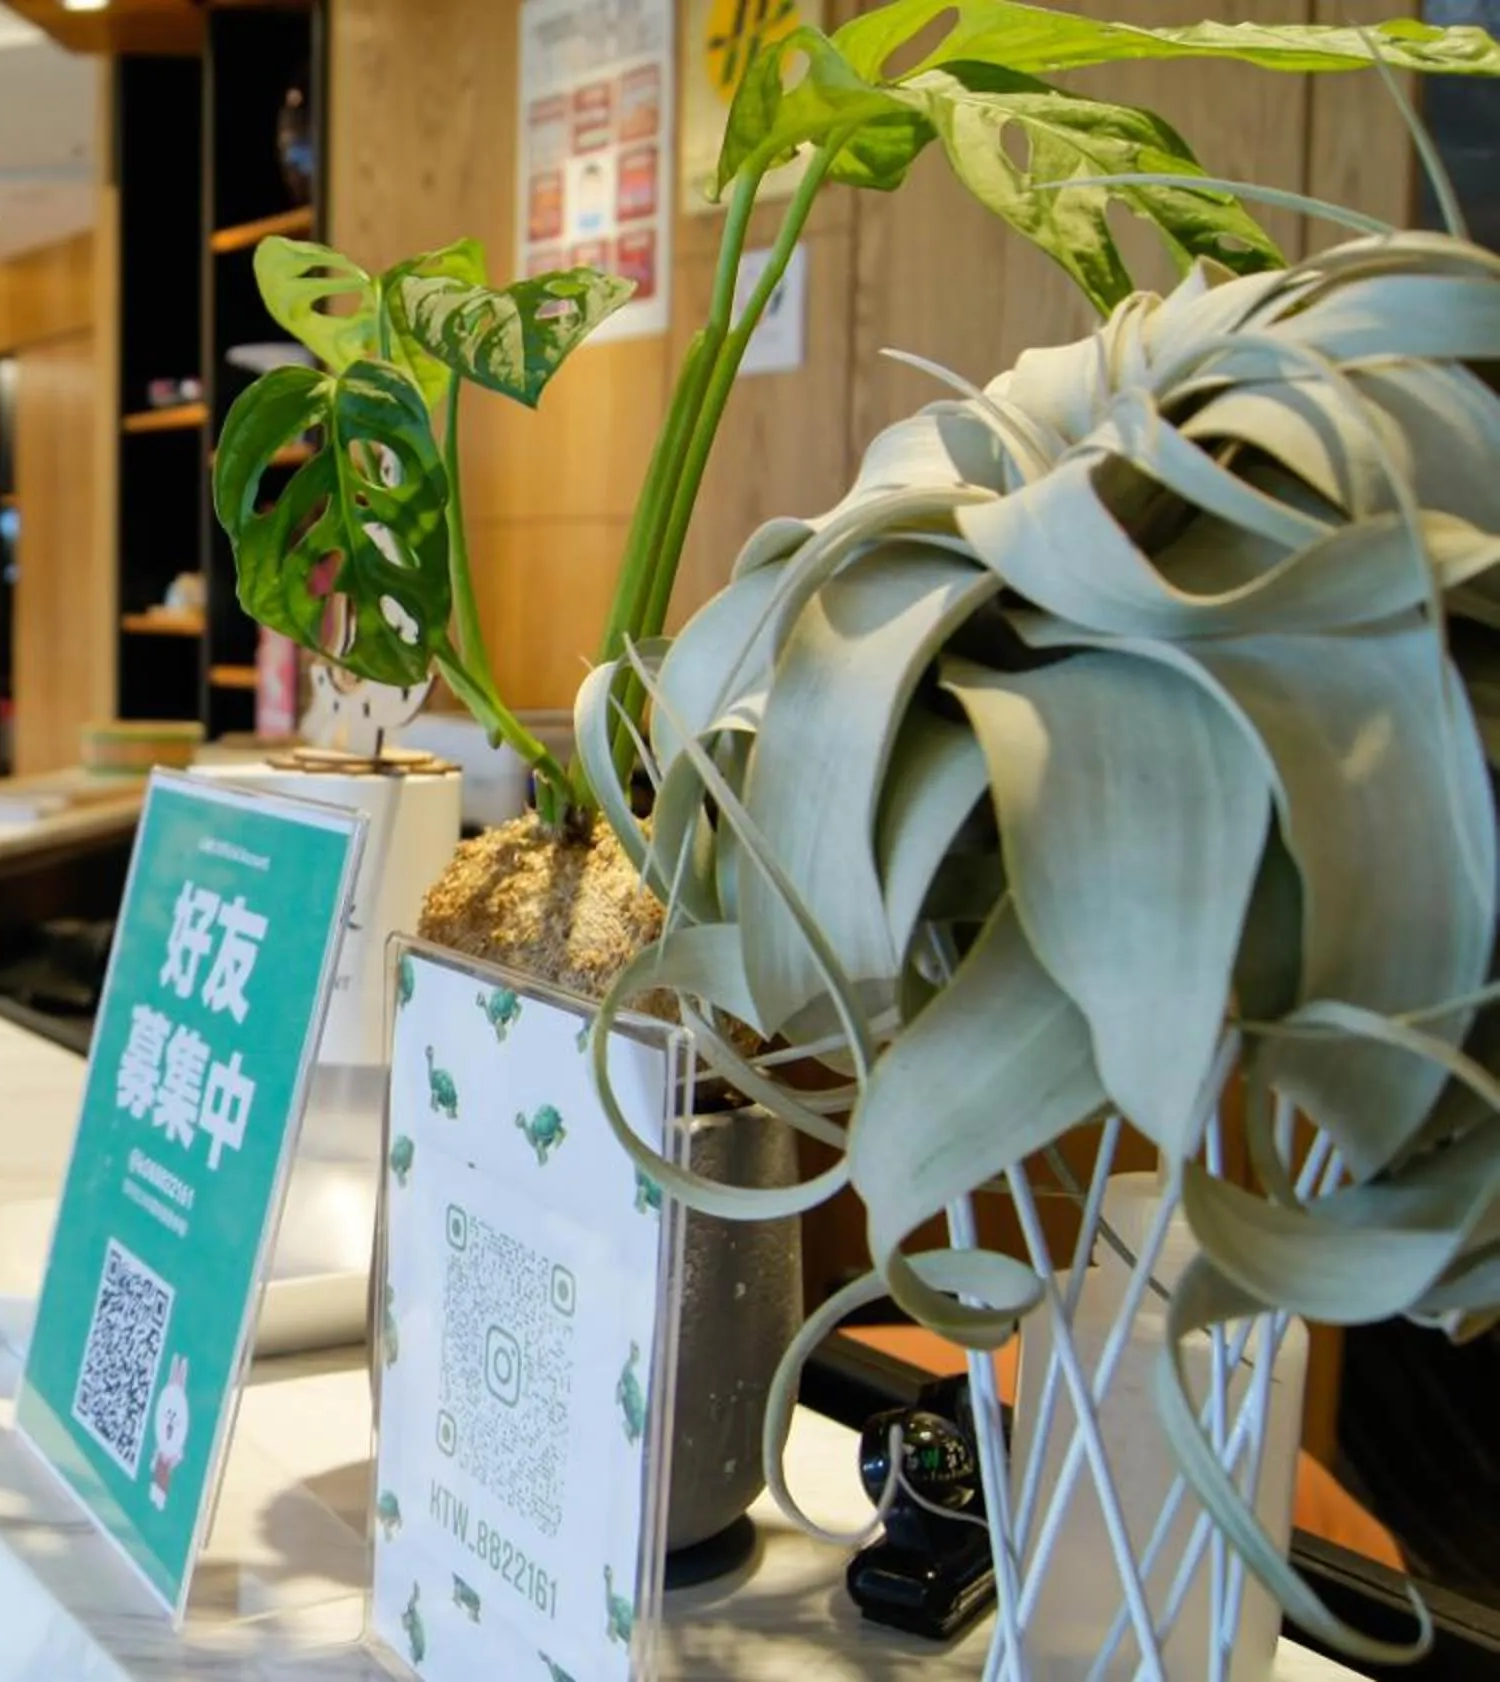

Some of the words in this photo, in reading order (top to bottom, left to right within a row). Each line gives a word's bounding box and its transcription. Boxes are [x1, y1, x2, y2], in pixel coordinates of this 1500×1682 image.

[160, 879, 269, 1024] 好友
[116, 1004, 257, 1171] 募集中
[430, 1477, 558, 1620] KTW_8822161
